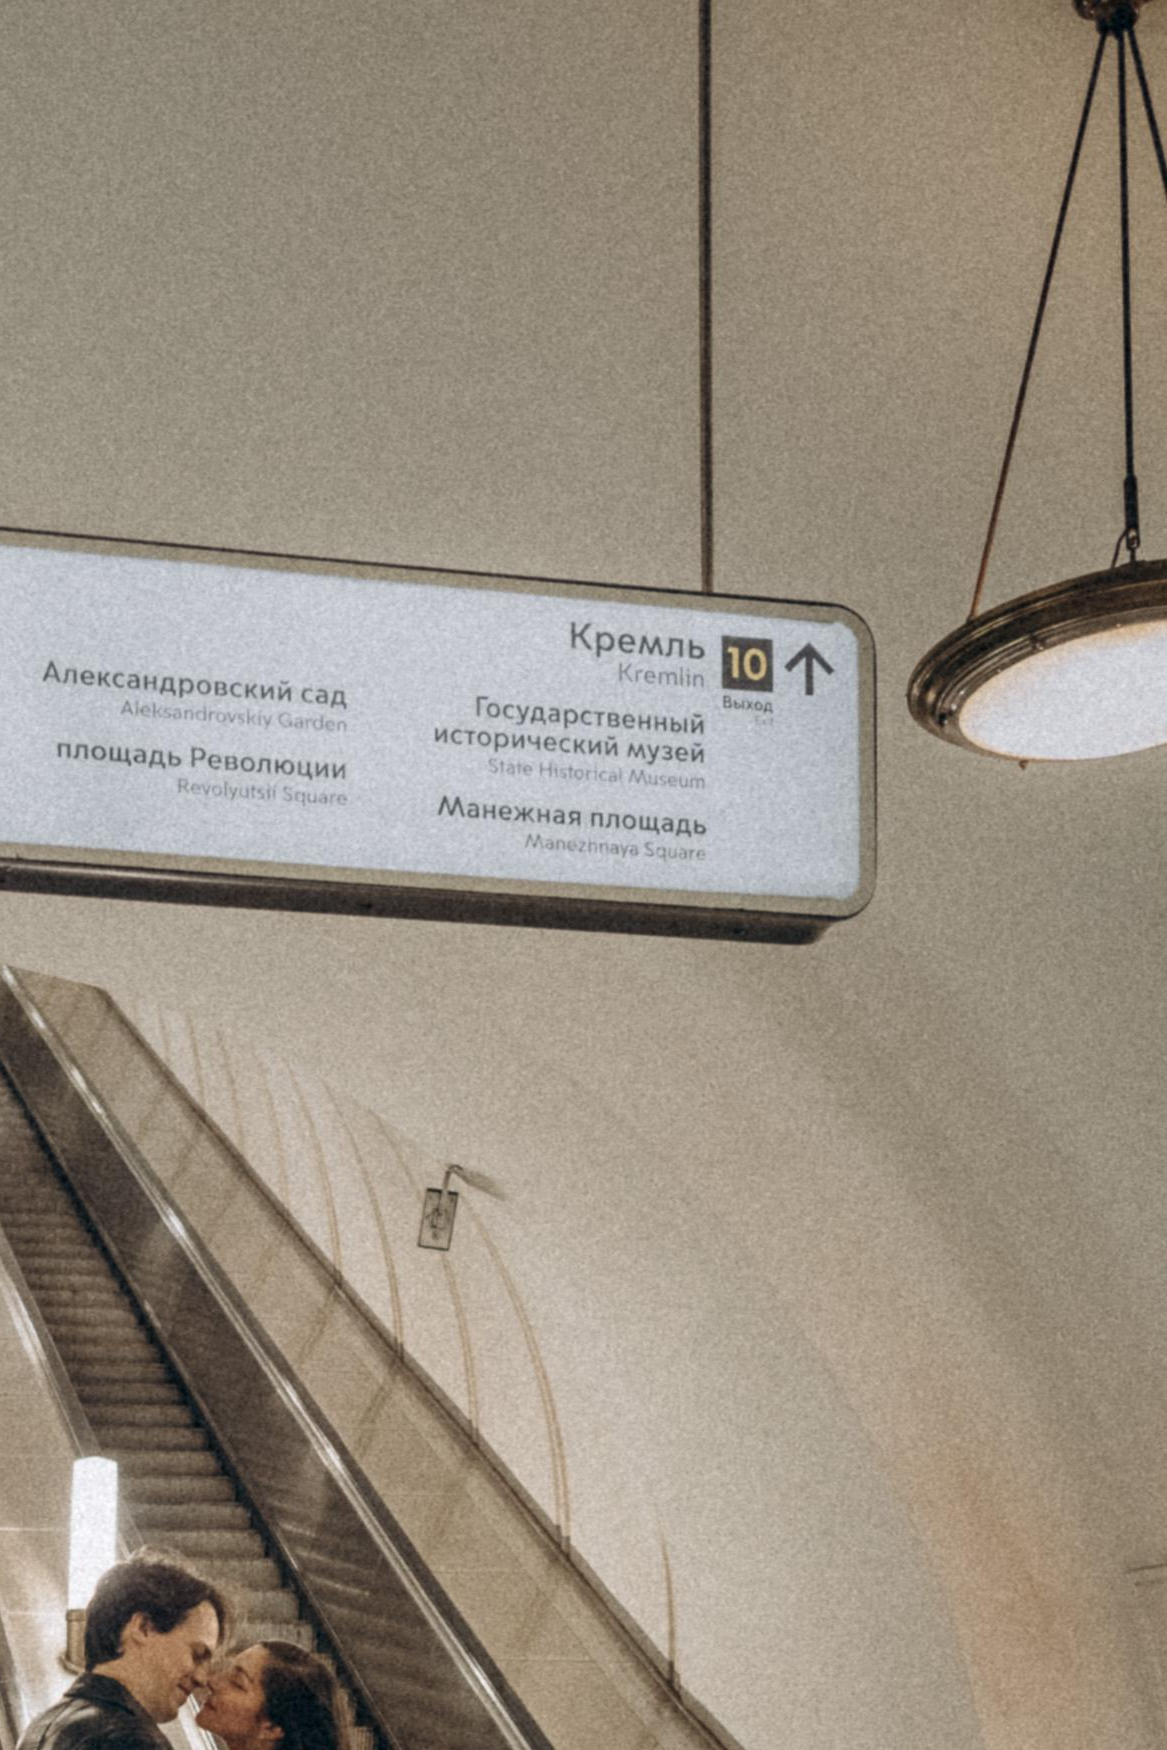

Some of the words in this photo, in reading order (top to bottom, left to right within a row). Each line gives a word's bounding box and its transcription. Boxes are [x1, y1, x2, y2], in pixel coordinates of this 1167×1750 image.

[570, 622, 705, 659] Кремль
[618, 662, 705, 687] Kremlin
[727, 646, 767, 681] 10
[42, 660, 292, 703] Александровский
[301, 687, 347, 709] сад
[120, 700, 272, 728] Aleksandrovskiy
[278, 713, 347, 732] Garden
[475, 696, 705, 735] Государственный
[723, 696, 773, 713] Выход
[56, 741, 181, 769] площадь
[190, 746, 346, 779] Революции
[434, 727, 619, 756] исторический
[627, 742, 705, 765] музей
[487, 758, 533, 776] State
[539, 762, 622, 783] Historical
[628, 769, 706, 789] Museum
[177, 777, 276, 801] Revolyutsii
[283, 785, 348, 806] Square
[437, 795, 582, 825] Манежная
[590, 812, 707, 837] площадь
[524, 834, 639, 858] Manezhnaya
[644, 842, 706, 862] Square
